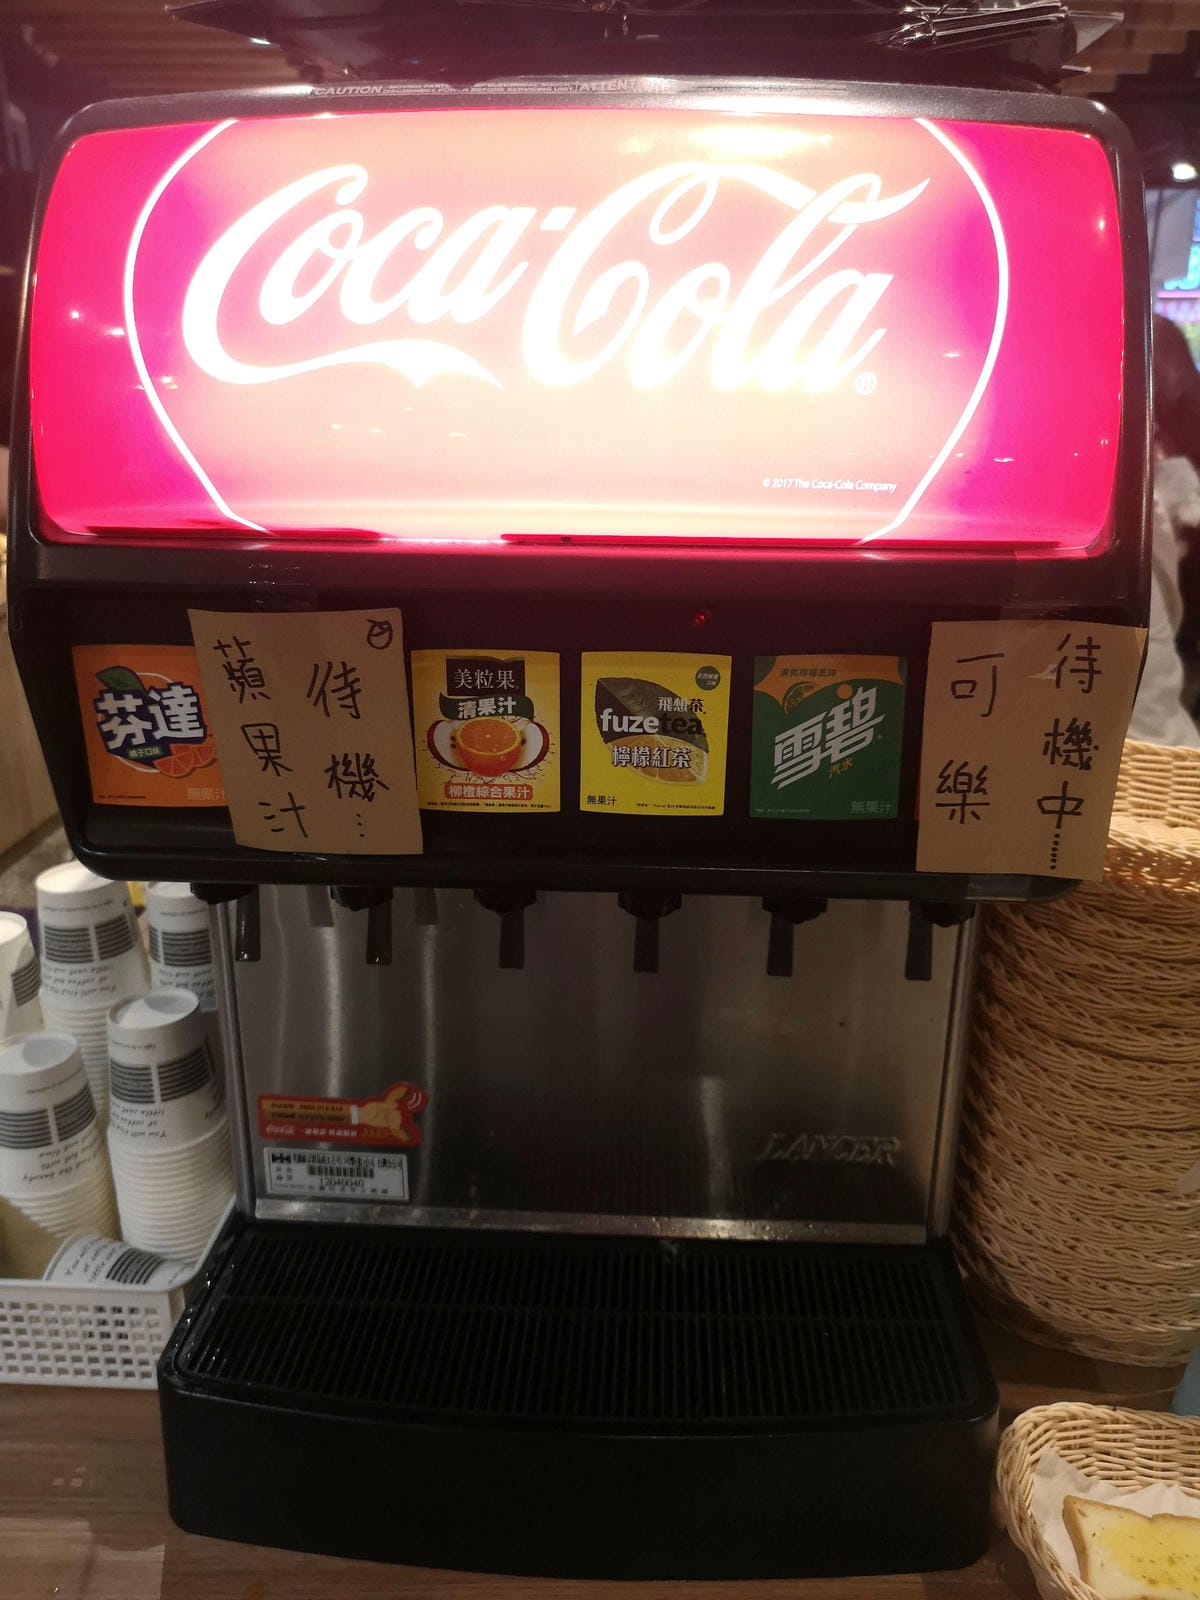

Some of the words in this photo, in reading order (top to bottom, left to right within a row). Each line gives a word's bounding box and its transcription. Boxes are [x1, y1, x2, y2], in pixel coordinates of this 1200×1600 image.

[314, 84, 384, 96] CAUTION
[183, 162, 931, 391] Coca-Cola
[771, 478, 794, 488] 2017
[794, 478, 811, 489] The
[811, 479, 855, 490] Coca-Cola
[855, 480, 897, 494] Company
[454, 668, 517, 690] 美粒果
[657, 696, 705, 713] 飛想茶
[97, 683, 205, 750] 芬達
[770, 686, 887, 791] 雪碧
[935, 652, 1005, 825] 可樂
[612, 746, 692, 769] 檸檬紅茶
[448, 785, 530, 799] 柳橙綜合果汁
[586, 795, 617, 806] 無果汁
[850, 800, 893, 814] 無果汁
